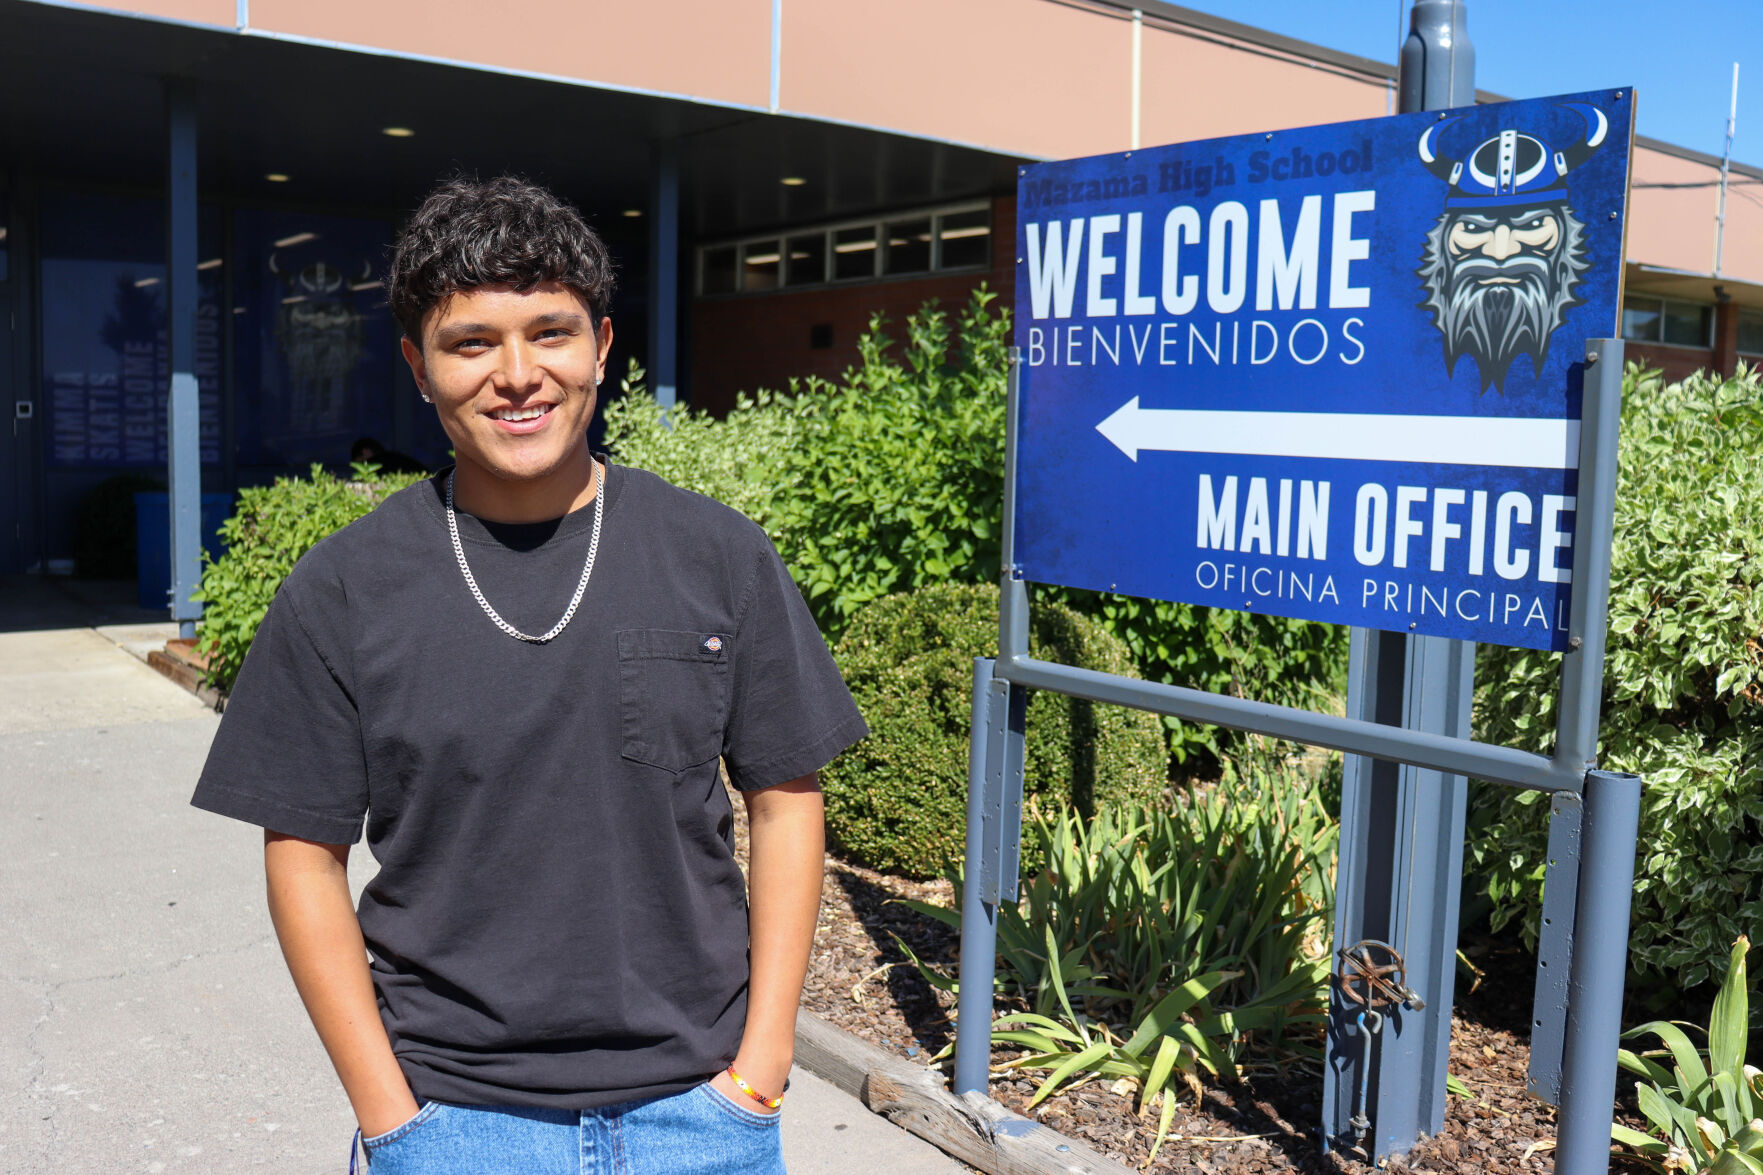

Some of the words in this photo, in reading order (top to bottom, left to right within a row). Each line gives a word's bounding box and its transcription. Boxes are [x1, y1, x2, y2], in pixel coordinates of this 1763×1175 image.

[1024, 173, 1148, 208] Mazama
[1158, 156, 1236, 196] High
[1247, 138, 1374, 183] School
[1026, 190, 1376, 320] WELCOME
[1028, 318, 1365, 367] BIENVENIDOS
[124, 340, 154, 461] WELCOME
[1197, 473, 1331, 561] MAIN
[1353, 482, 1577, 584] OFFICE
[1196, 561, 1339, 605] OFICINA
[1362, 579, 1569, 632] PRINCIPAL
